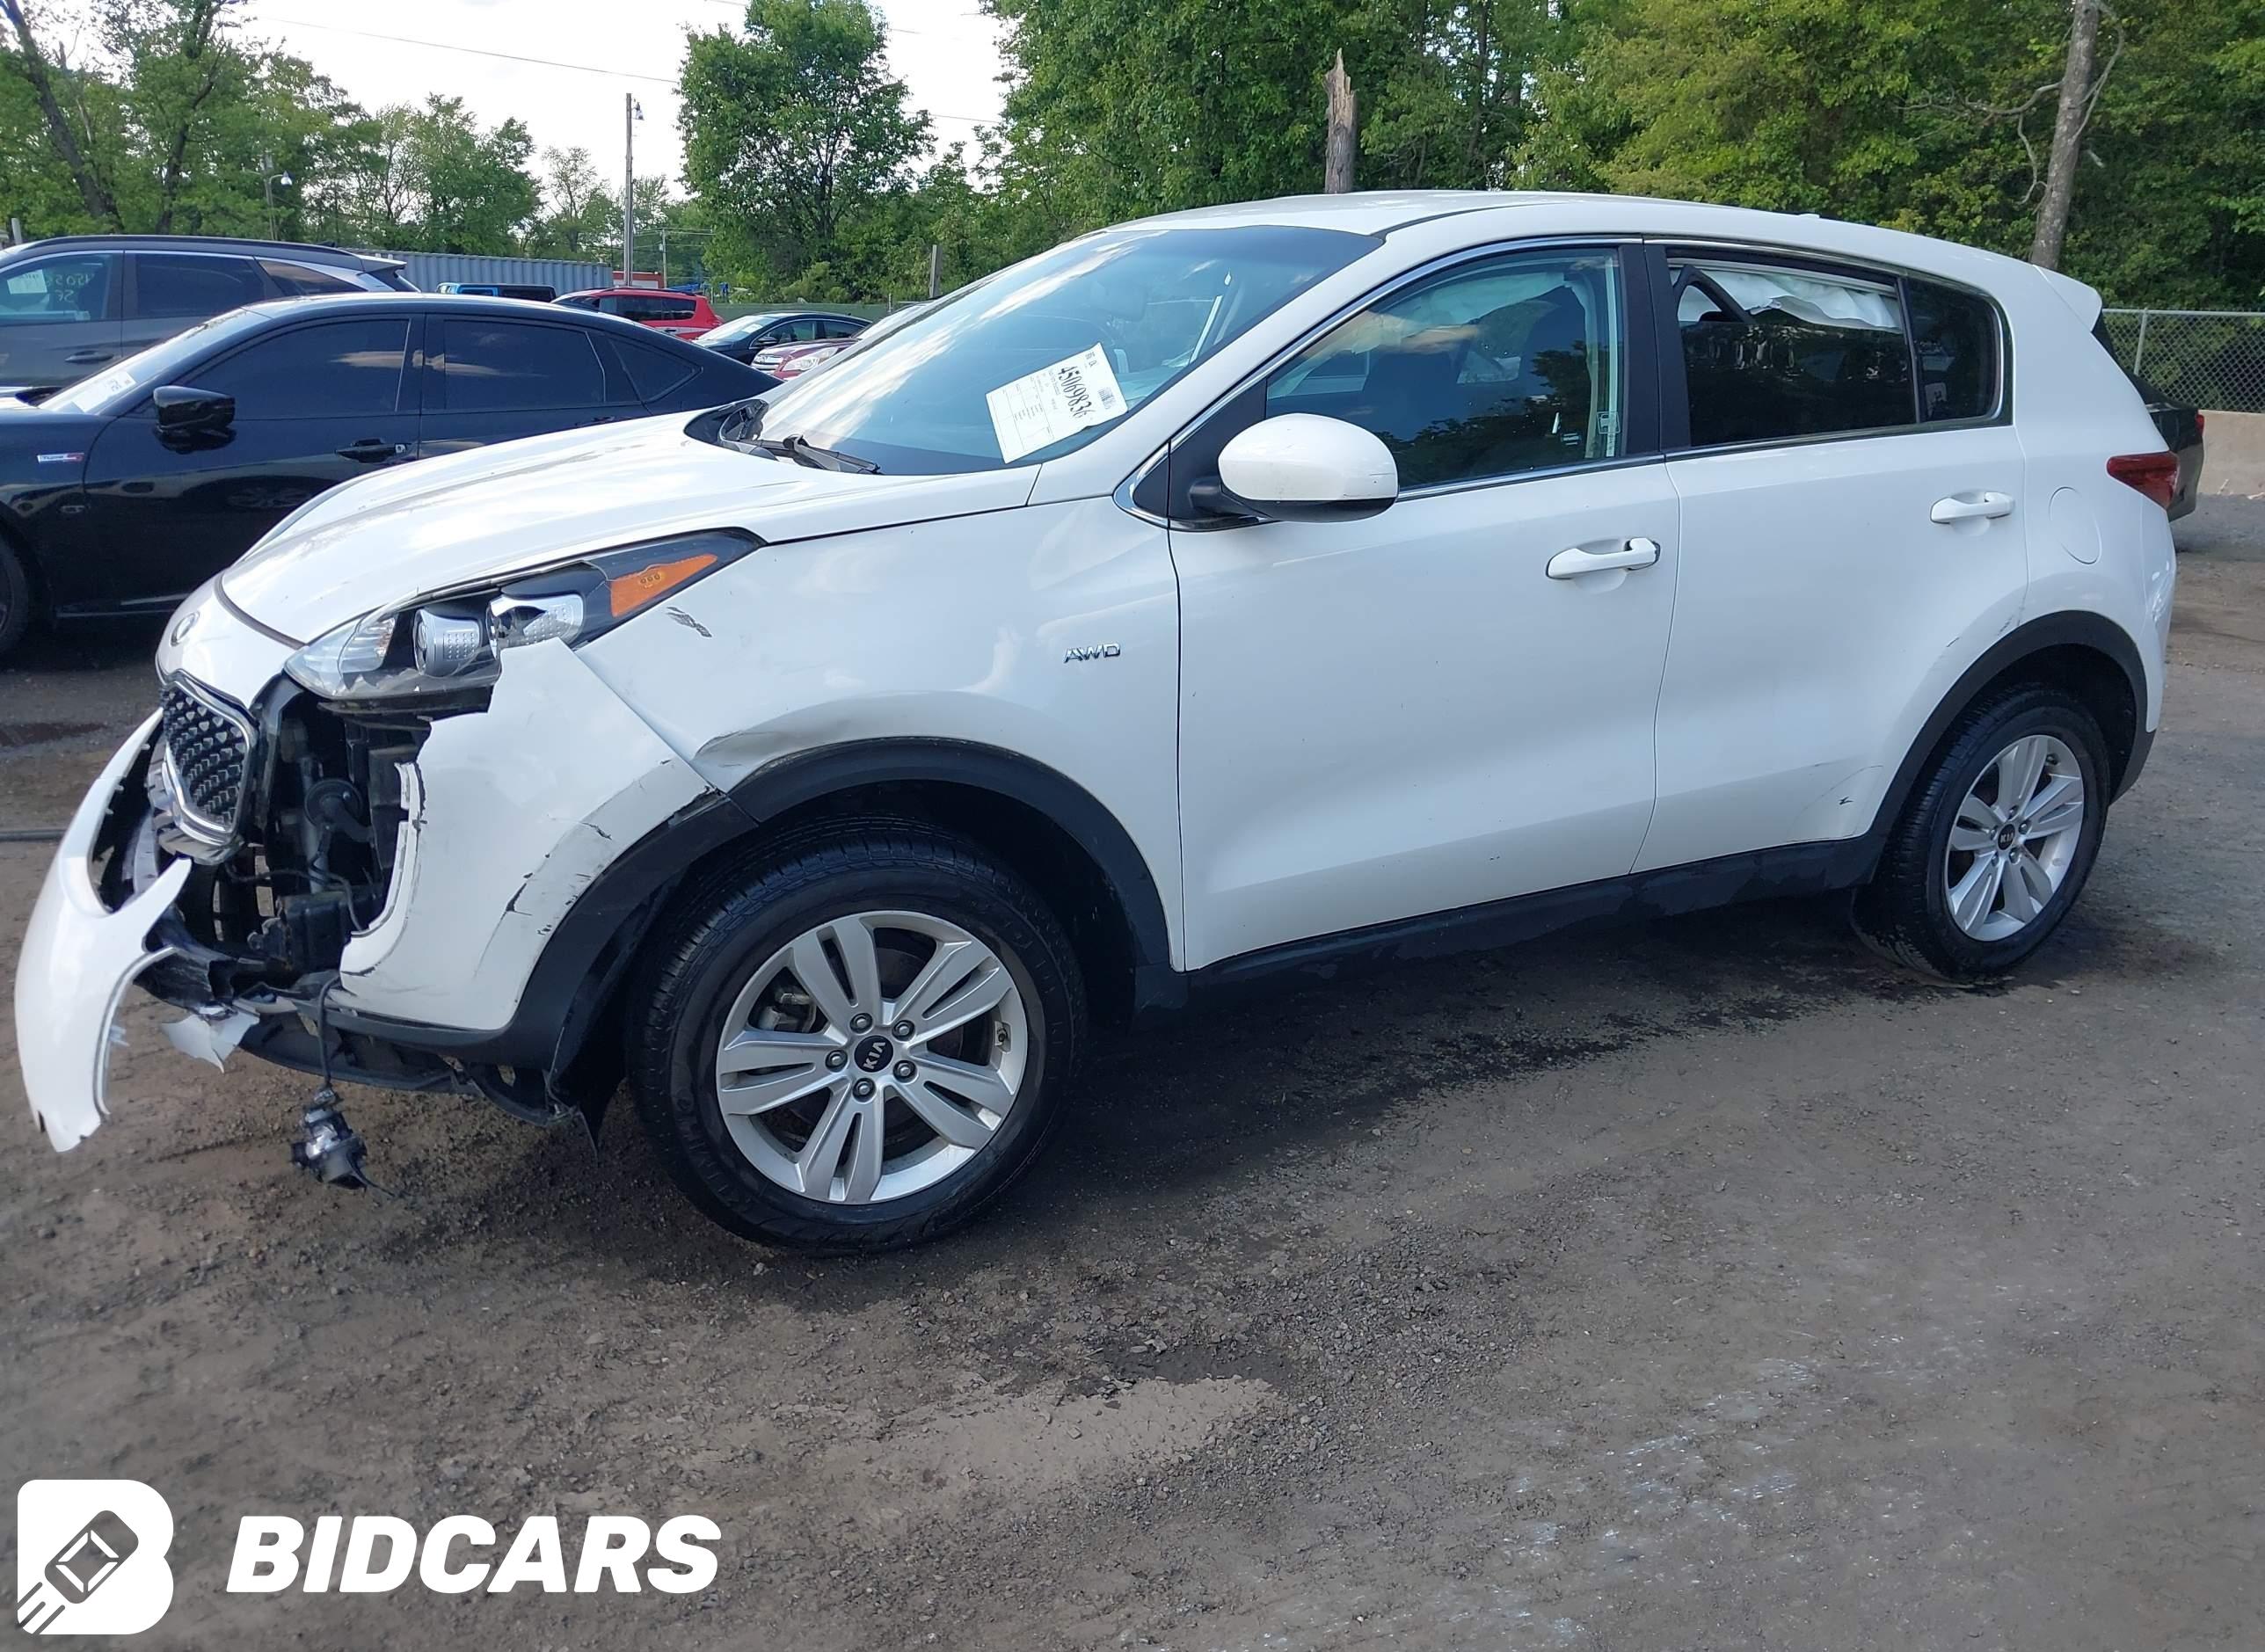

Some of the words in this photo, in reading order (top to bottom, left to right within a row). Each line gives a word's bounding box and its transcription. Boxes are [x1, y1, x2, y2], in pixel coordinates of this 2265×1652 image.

[1057, 366, 1096, 419] 45069836
[1063, 643, 1121, 664] AWD
[863, 1042, 886, 1070] KIA
